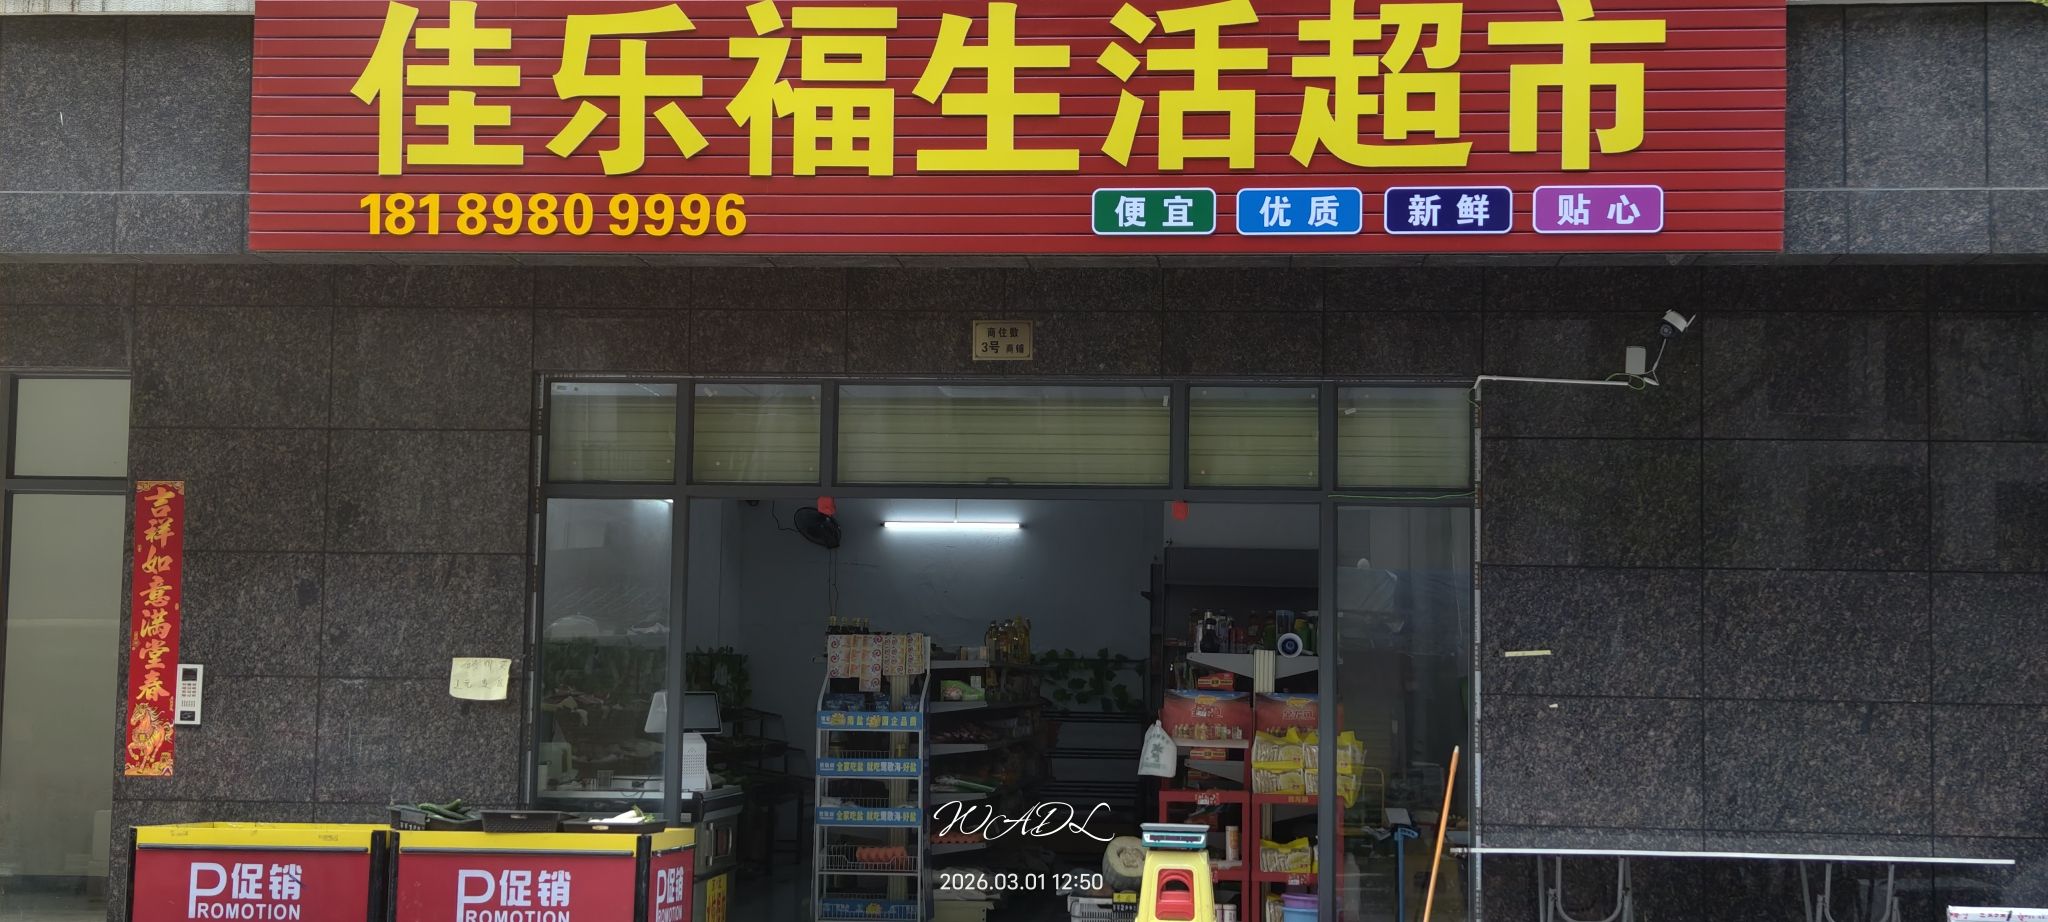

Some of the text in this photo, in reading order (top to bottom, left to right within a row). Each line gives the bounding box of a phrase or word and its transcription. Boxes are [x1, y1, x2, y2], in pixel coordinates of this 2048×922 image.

[351, 0, 1666, 176] 佳乐福生活超市
[360, 193, 746, 236] 181 8980 9996
[1115, 196, 1193, 226] 便宜
[1260, 196, 1339, 226] 优质
[1408, 194, 1489, 226] 新鲜
[1558, 193, 1640, 225] 贴心
[981, 341, 1000, 353] 3号
[136, 487, 175, 701] 吉祥如意满堂春
[231, 863, 302, 901] 促销
[500, 869, 571, 907] 促销
